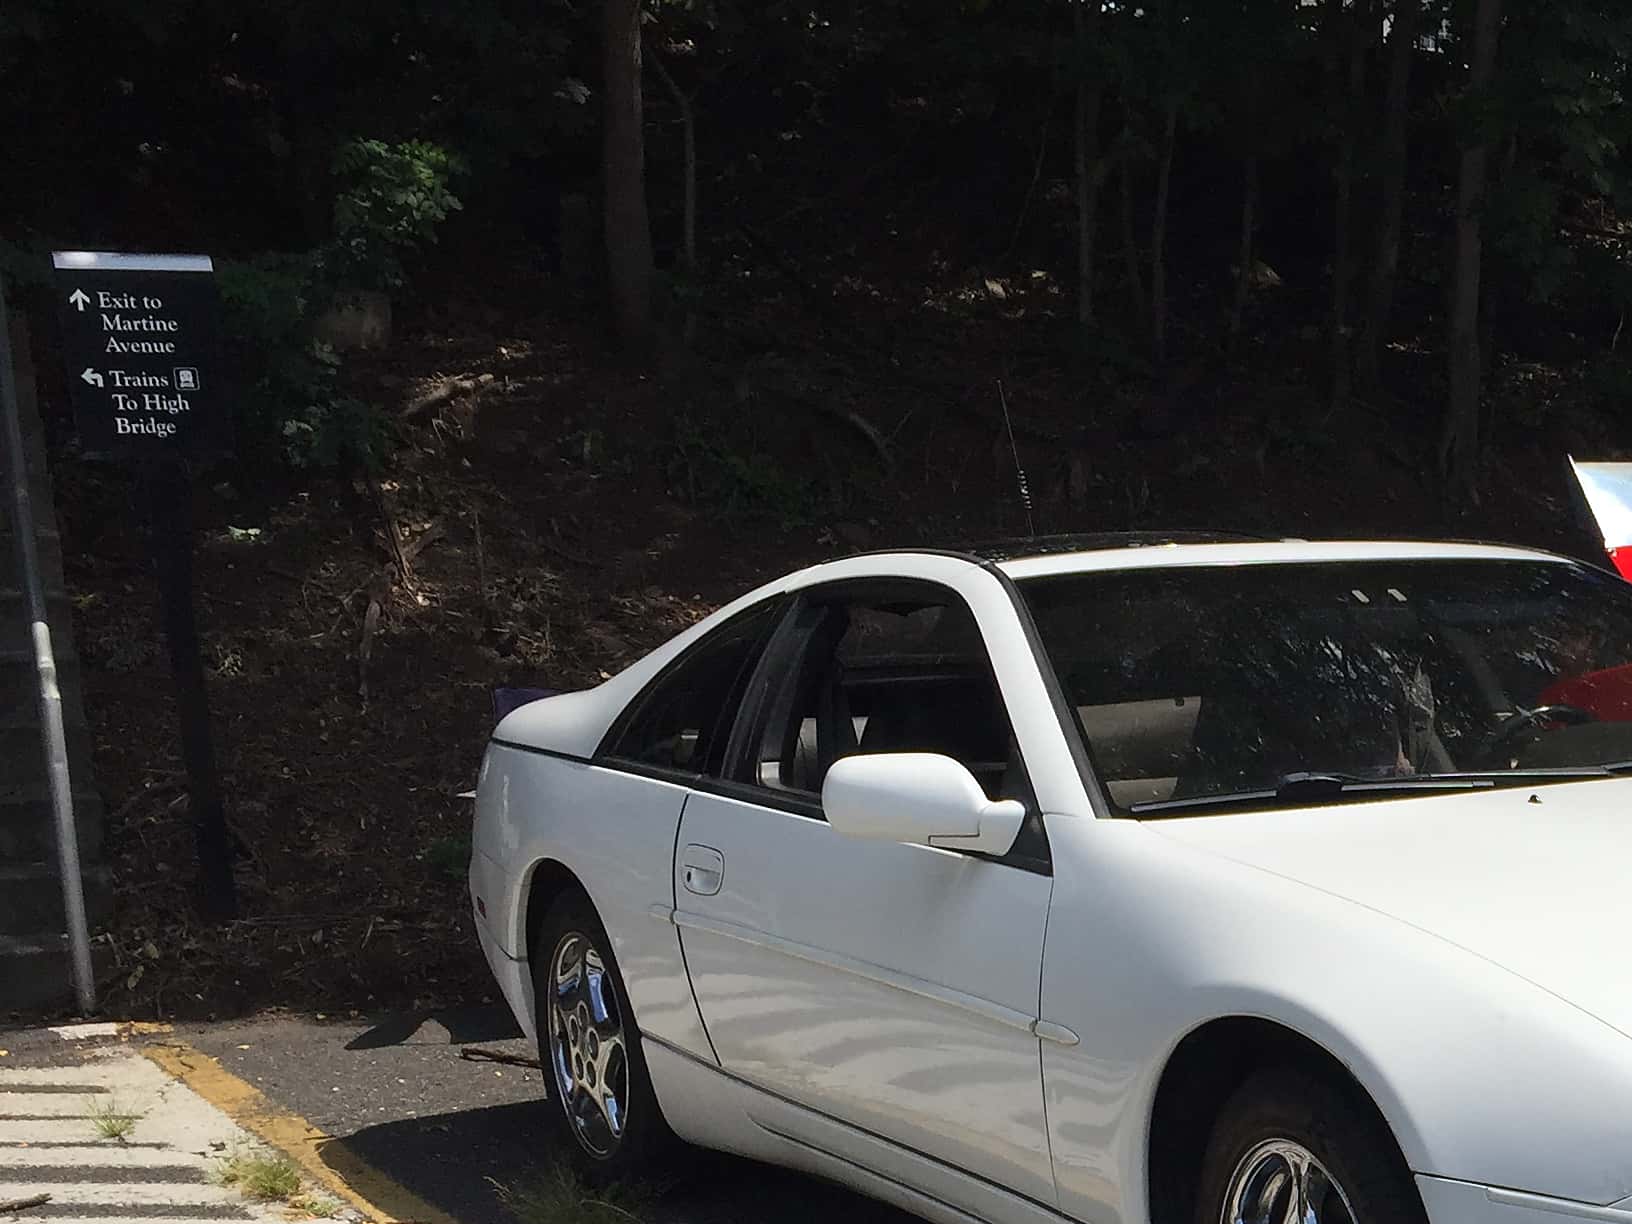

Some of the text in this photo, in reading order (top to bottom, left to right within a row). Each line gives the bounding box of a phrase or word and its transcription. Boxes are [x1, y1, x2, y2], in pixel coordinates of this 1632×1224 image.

[97, 291, 162, 310] Exit to
[100, 313, 178, 332] Martine
[105, 336, 176, 354] Avenue
[109, 370, 169, 388] Trains
[112, 393, 190, 415] To High
[115, 417, 177, 437] Bridge
